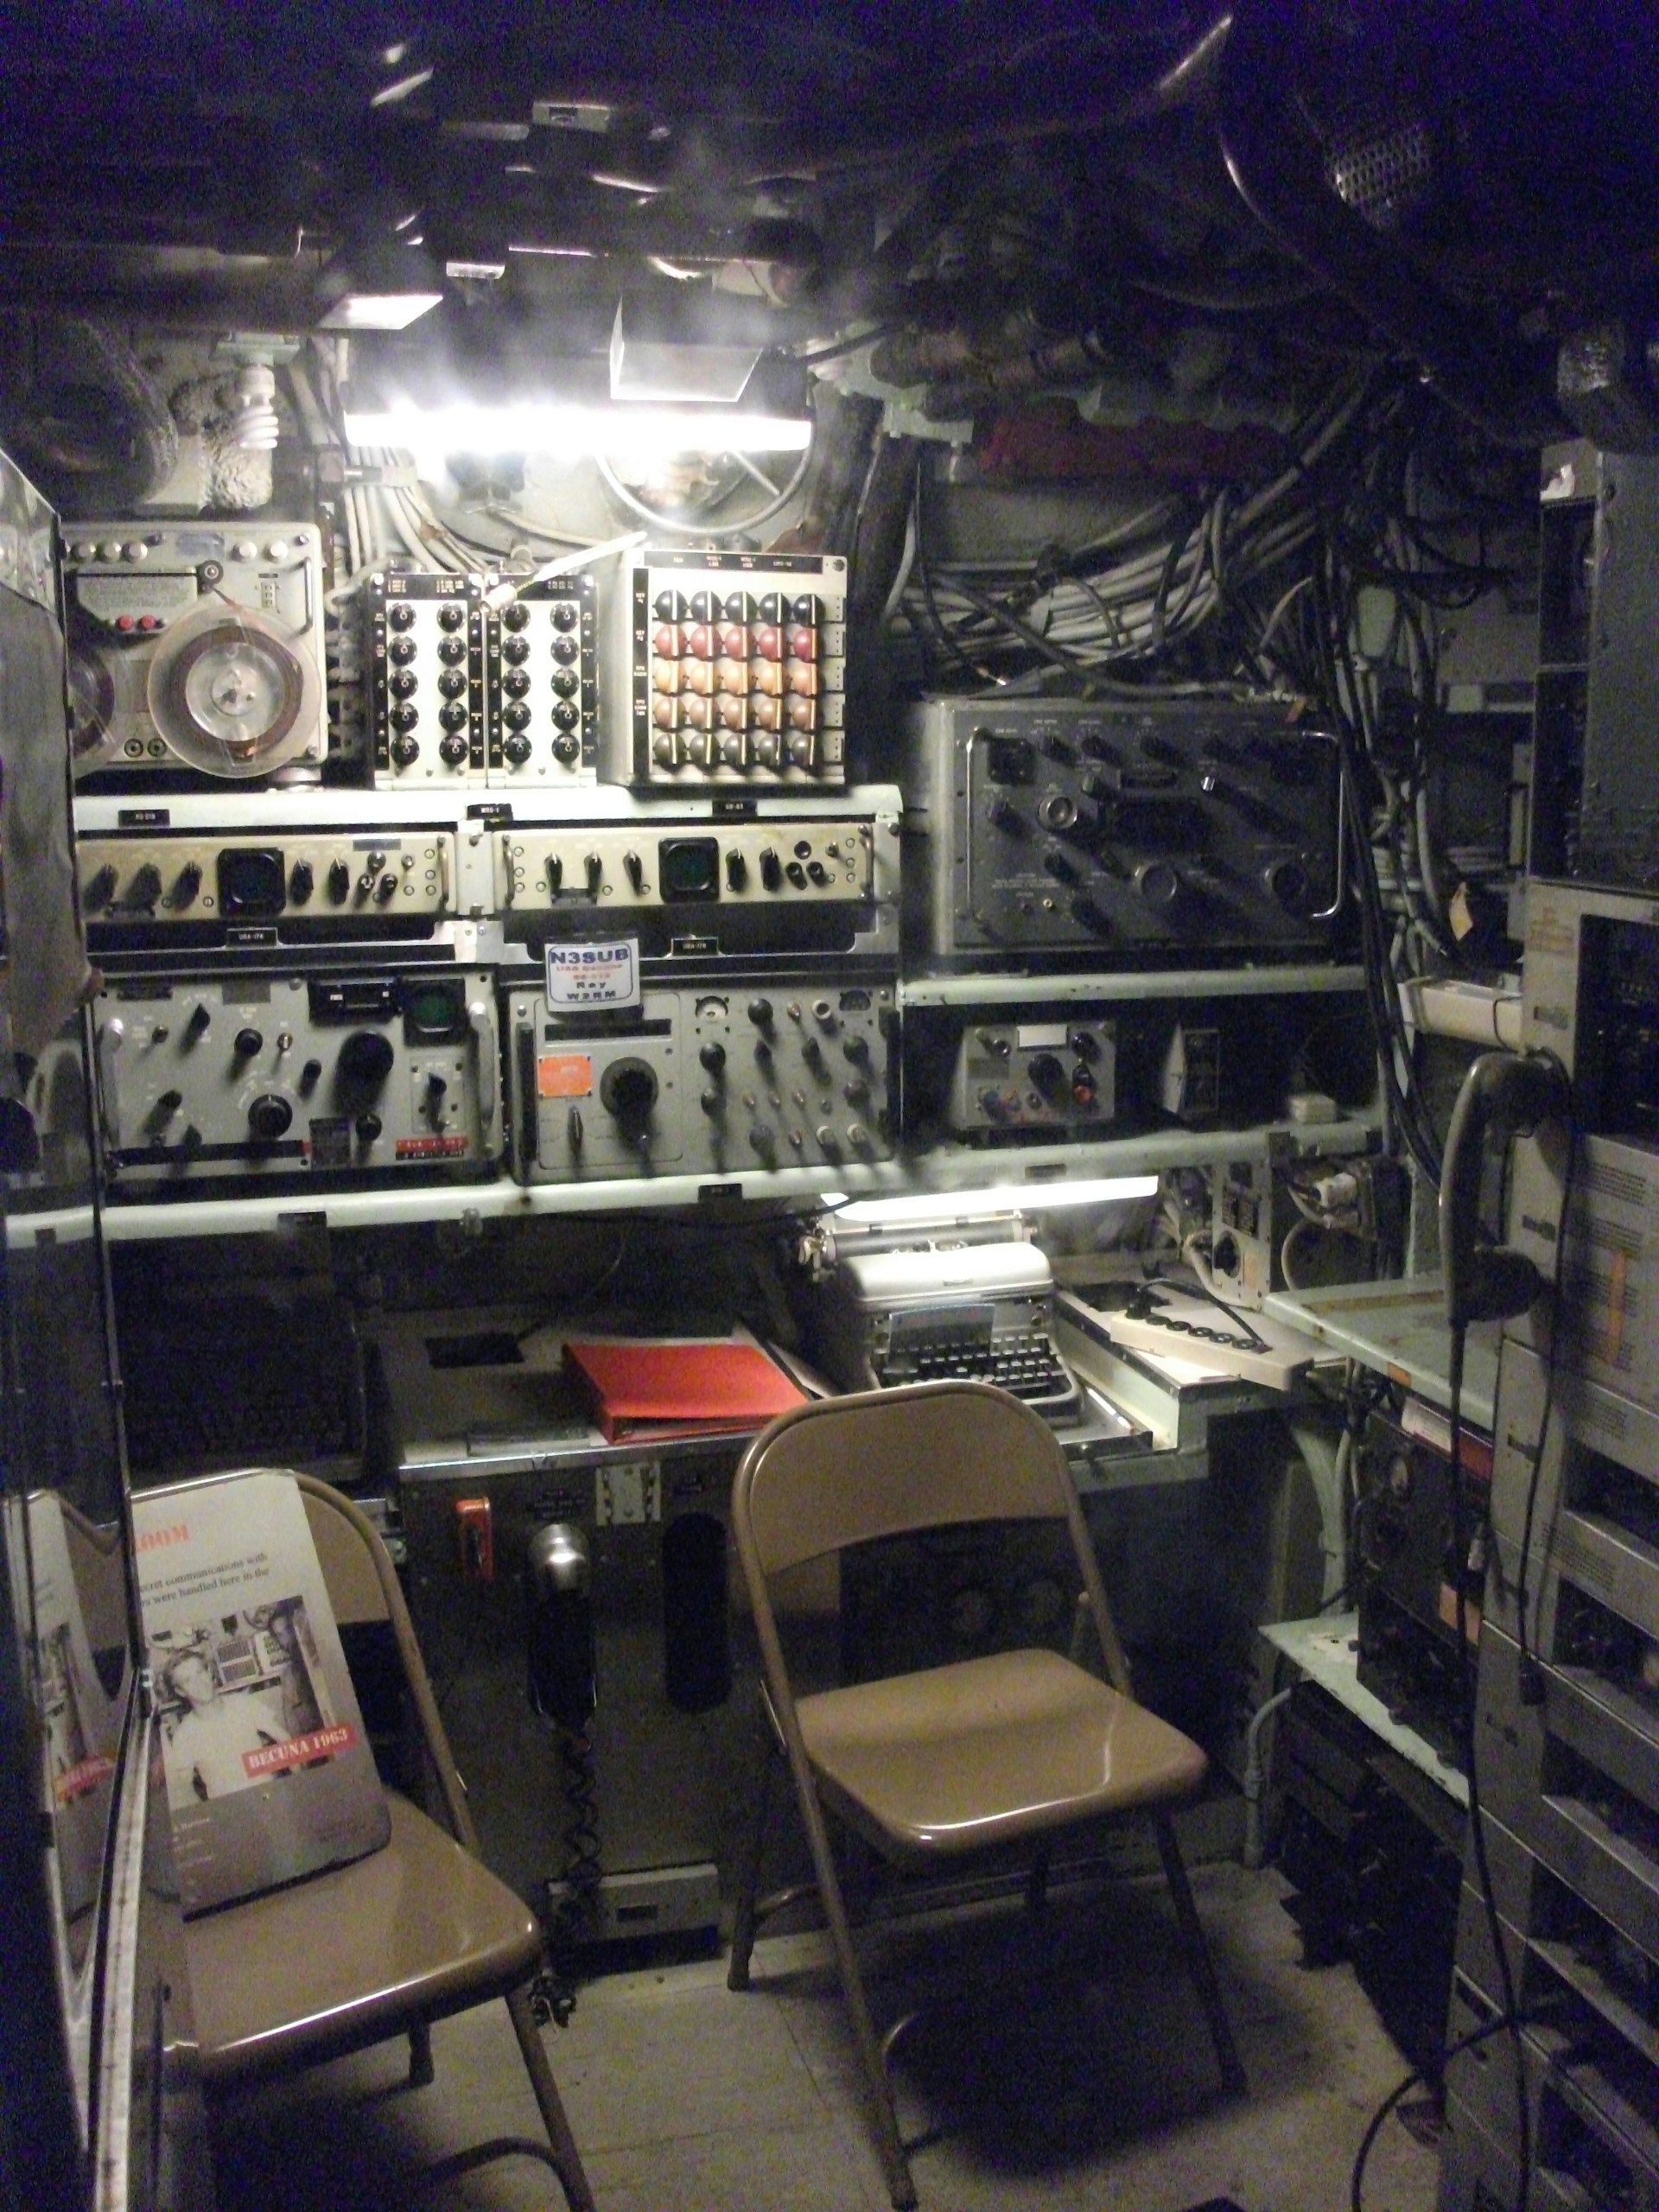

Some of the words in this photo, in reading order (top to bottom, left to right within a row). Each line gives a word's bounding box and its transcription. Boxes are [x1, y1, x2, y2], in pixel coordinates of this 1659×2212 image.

[550, 948, 629, 964] N3SUB
[179, 1580, 218, 1598] handled
[248, 1740, 309, 1769] BECUNA
[313, 1727, 347, 1750] 1963
